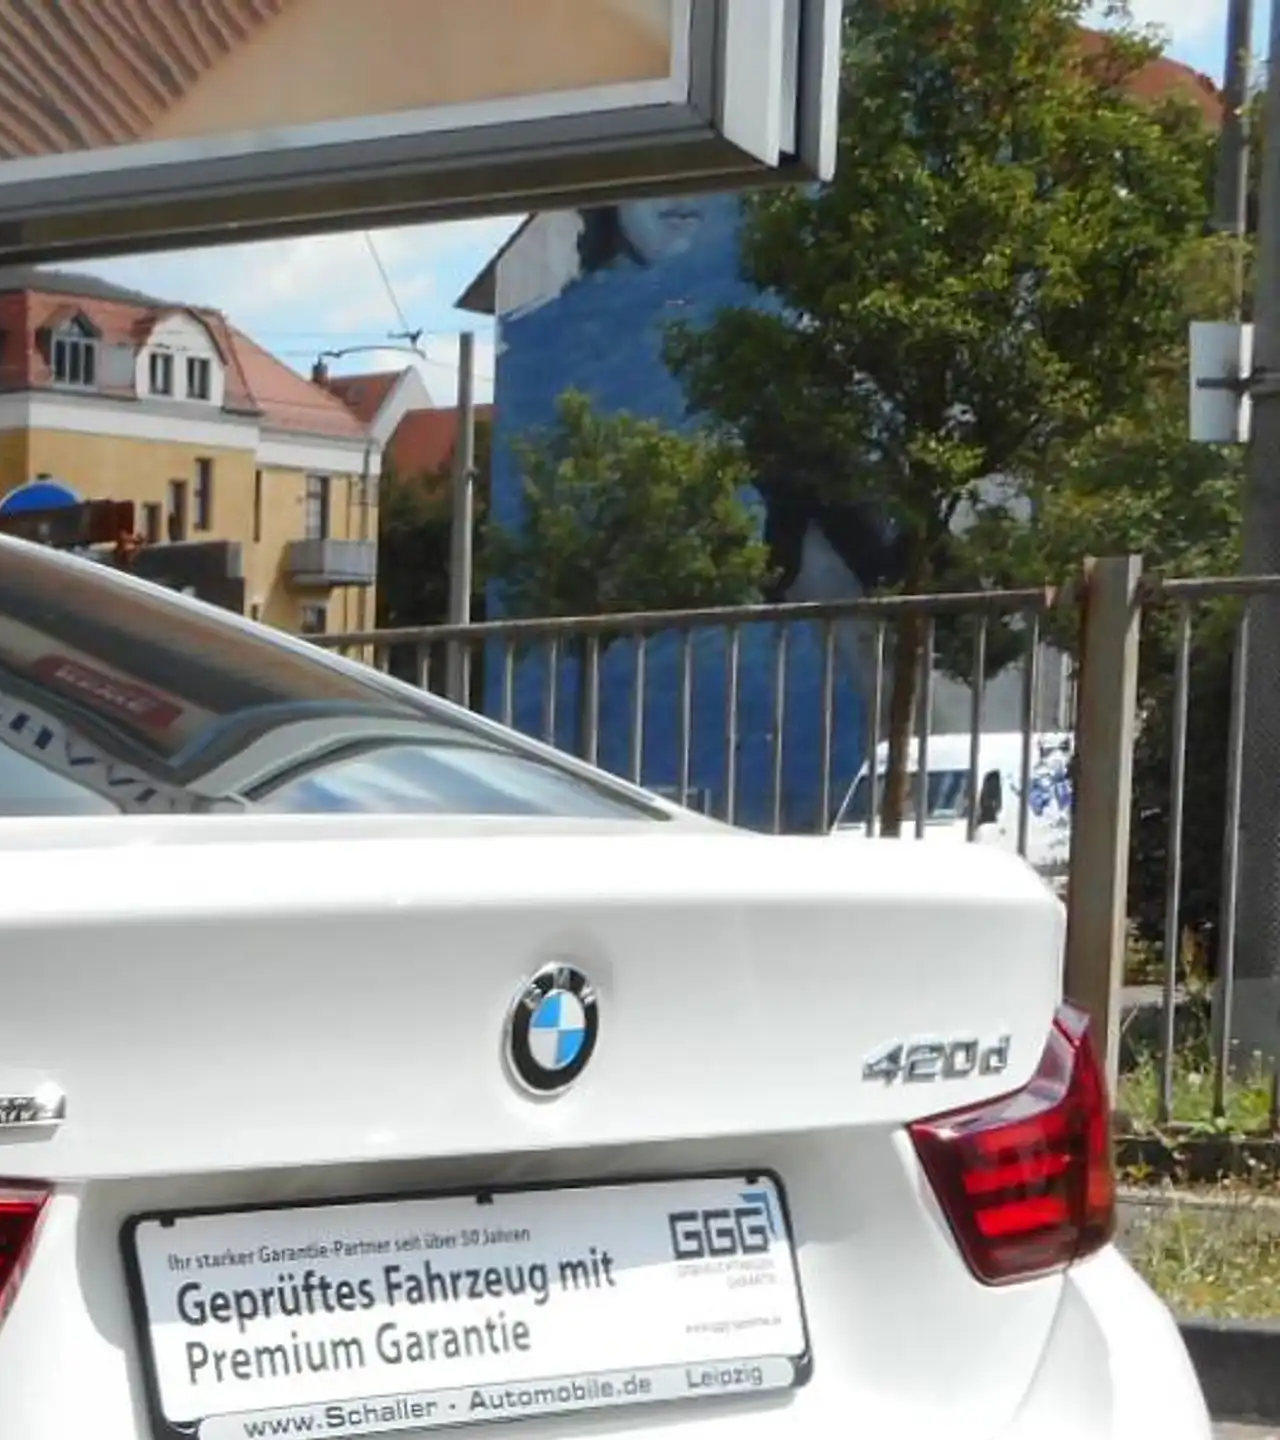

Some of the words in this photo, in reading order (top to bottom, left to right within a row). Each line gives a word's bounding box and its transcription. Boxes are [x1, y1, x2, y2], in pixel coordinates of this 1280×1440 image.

[861, 1033, 1013, 1087] 420d
[167, 1252, 192, 1272] Ihr
[195, 1248, 254, 1271] starker
[258, 1236, 391, 1263] Garantie-Partner
[393, 1233, 422, 1253] seit
[424, 1230, 458, 1251] über
[482, 1225, 532, 1245] Jahren
[668, 1206, 770, 1260] GGG
[176, 1269, 376, 1333] Geprüftes
[384, 1257, 550, 1306] Fahrzeug
[558, 1246, 616, 1290] mit
[185, 1331, 367, 1385] Premium
[375, 1310, 532, 1365] Garantie
[685, 1364, 764, 1390] Leipzig
